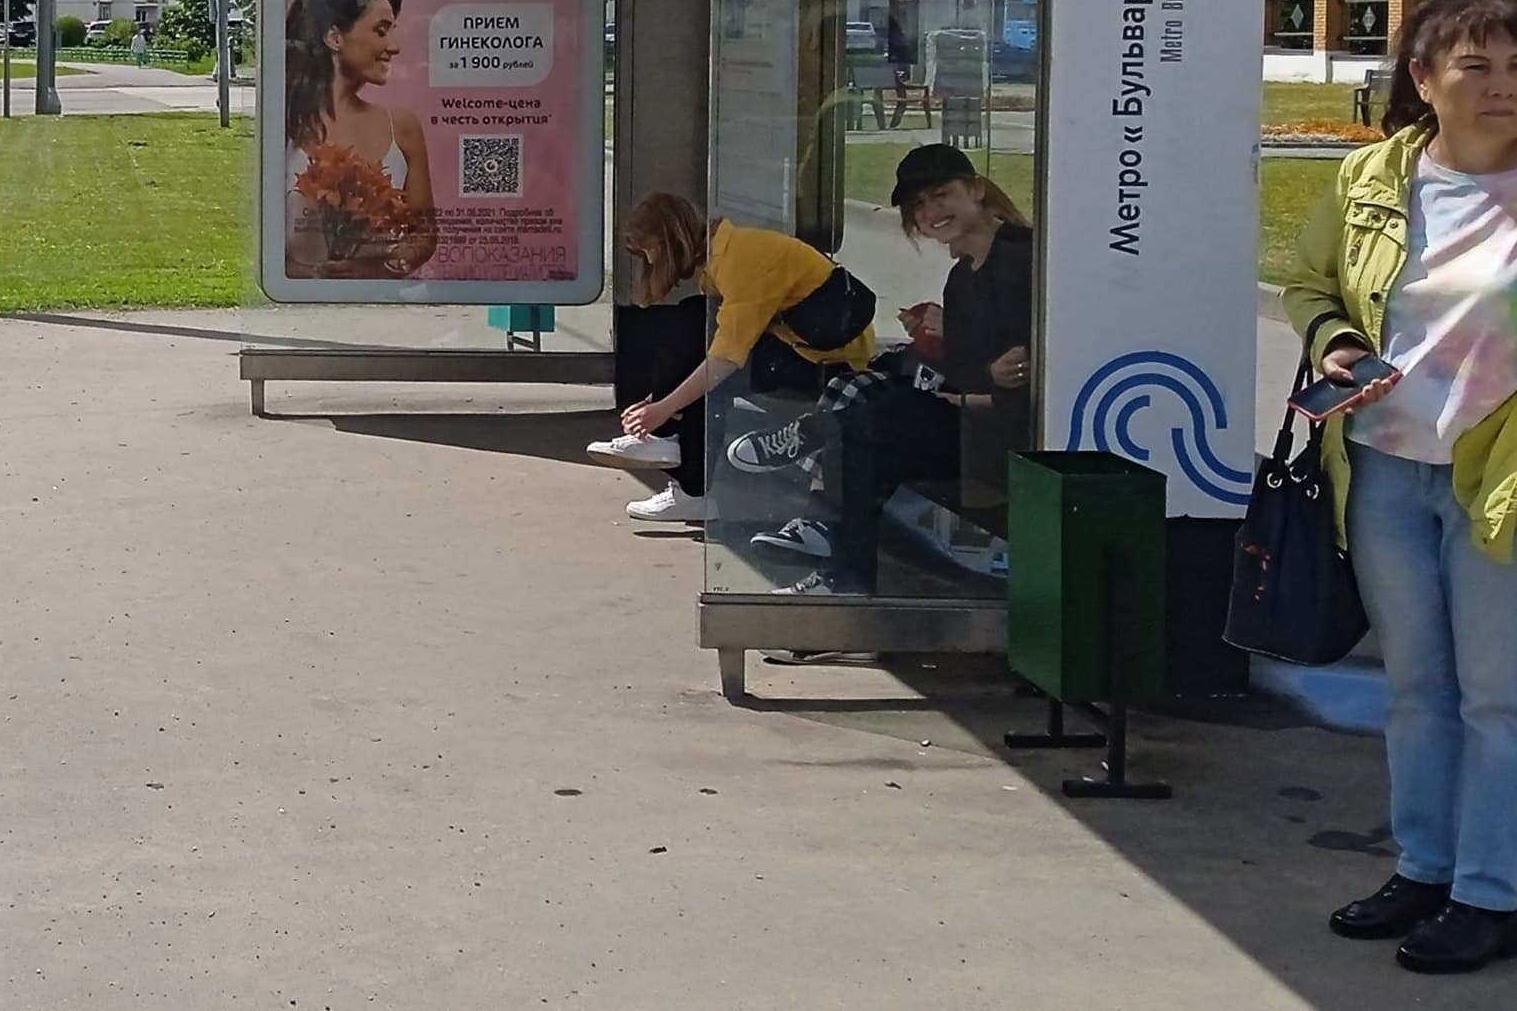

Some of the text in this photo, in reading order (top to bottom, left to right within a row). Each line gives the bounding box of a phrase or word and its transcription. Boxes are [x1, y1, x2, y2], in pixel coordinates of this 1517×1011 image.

[463, 17, 520, 31] ПРИЕМ
[439, 36, 544, 50] ГИНЕКОЛОГА
[1160, 19, 1183, 63] Metro
[441, 97, 542, 110] Welcome-цена
[431, 115, 439, 125] в
[442, 114, 480, 126] честь
[1109, 149, 1148, 255] Метро
